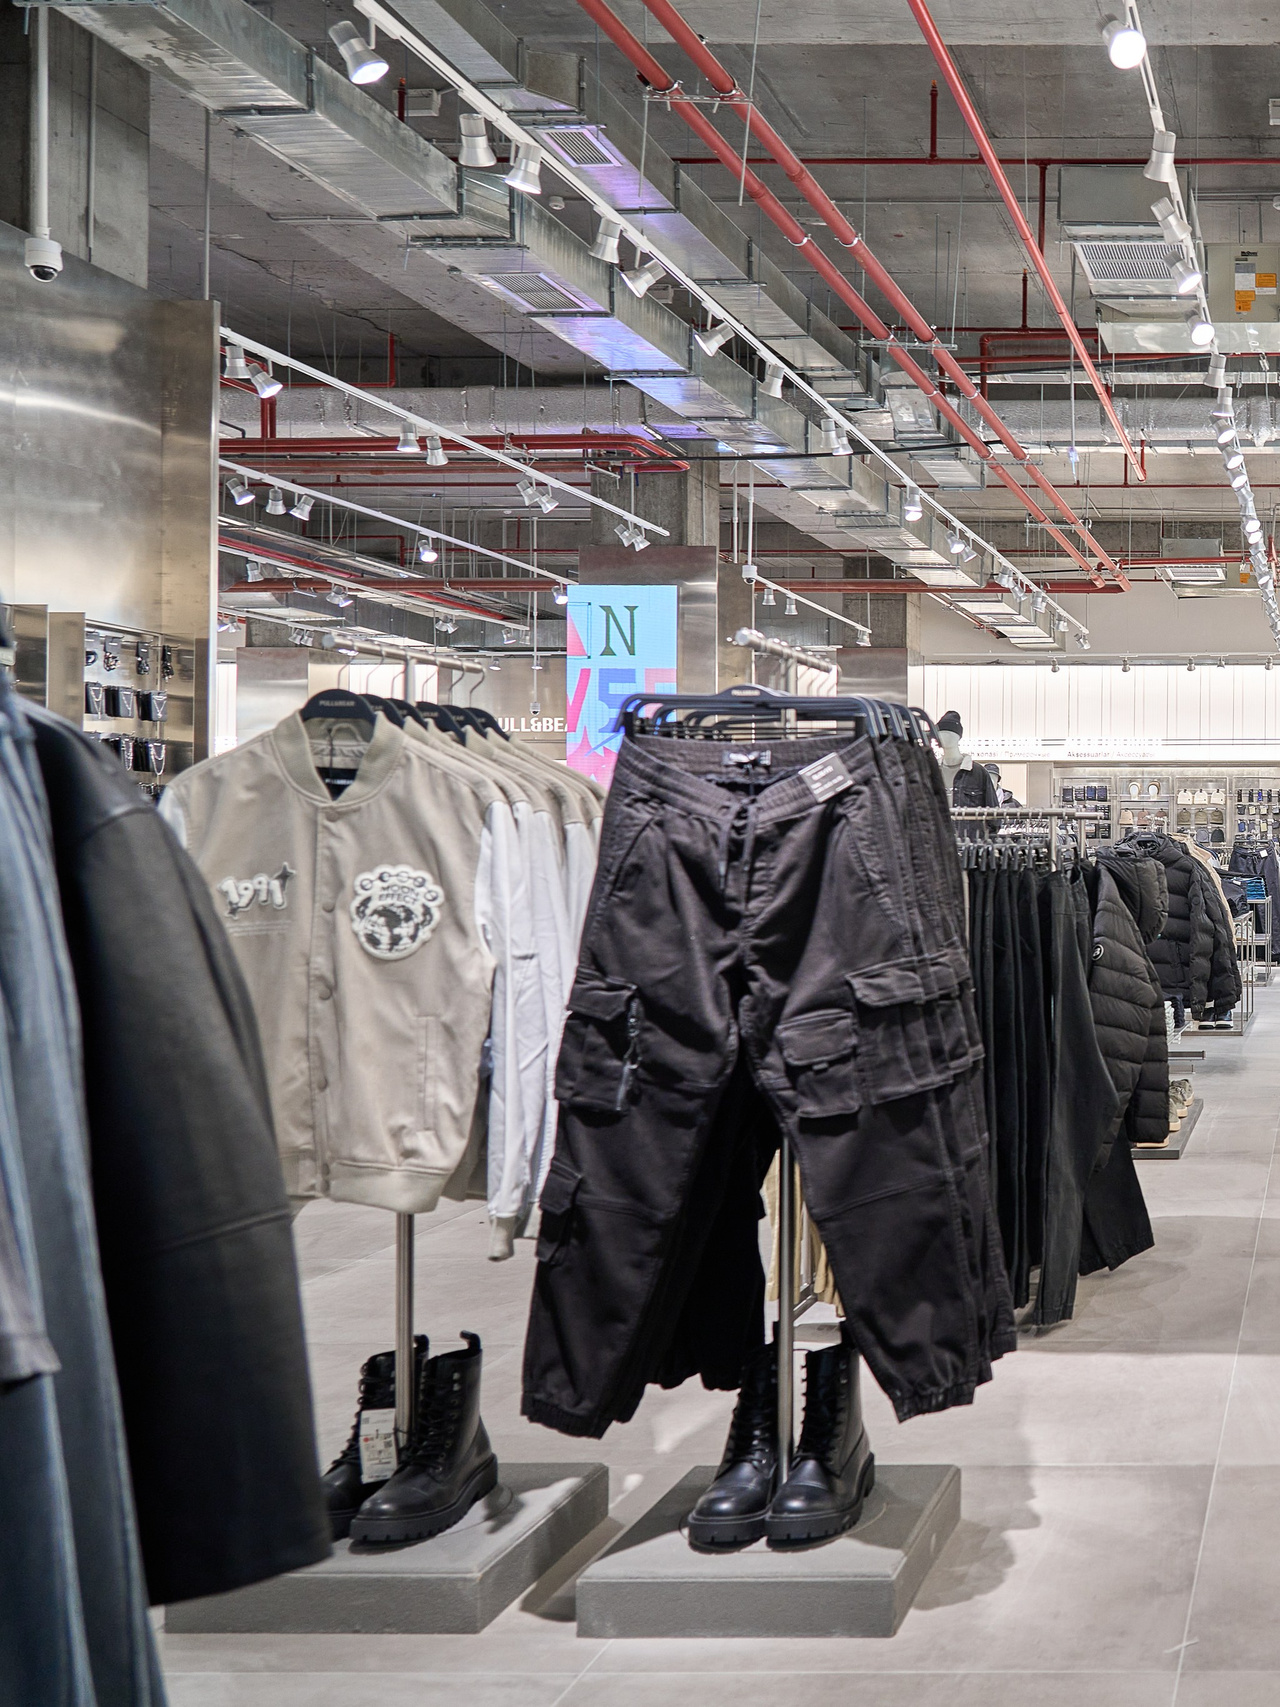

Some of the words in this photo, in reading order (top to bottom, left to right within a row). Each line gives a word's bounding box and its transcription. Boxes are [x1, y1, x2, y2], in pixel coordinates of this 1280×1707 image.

[599, 605, 639, 656] N
[497, 717, 567, 732] ULL&BE
[220, 874, 286, 910] 1991
[378, 892, 418, 905] EFFECT
[380, 884, 420, 898] MOON
